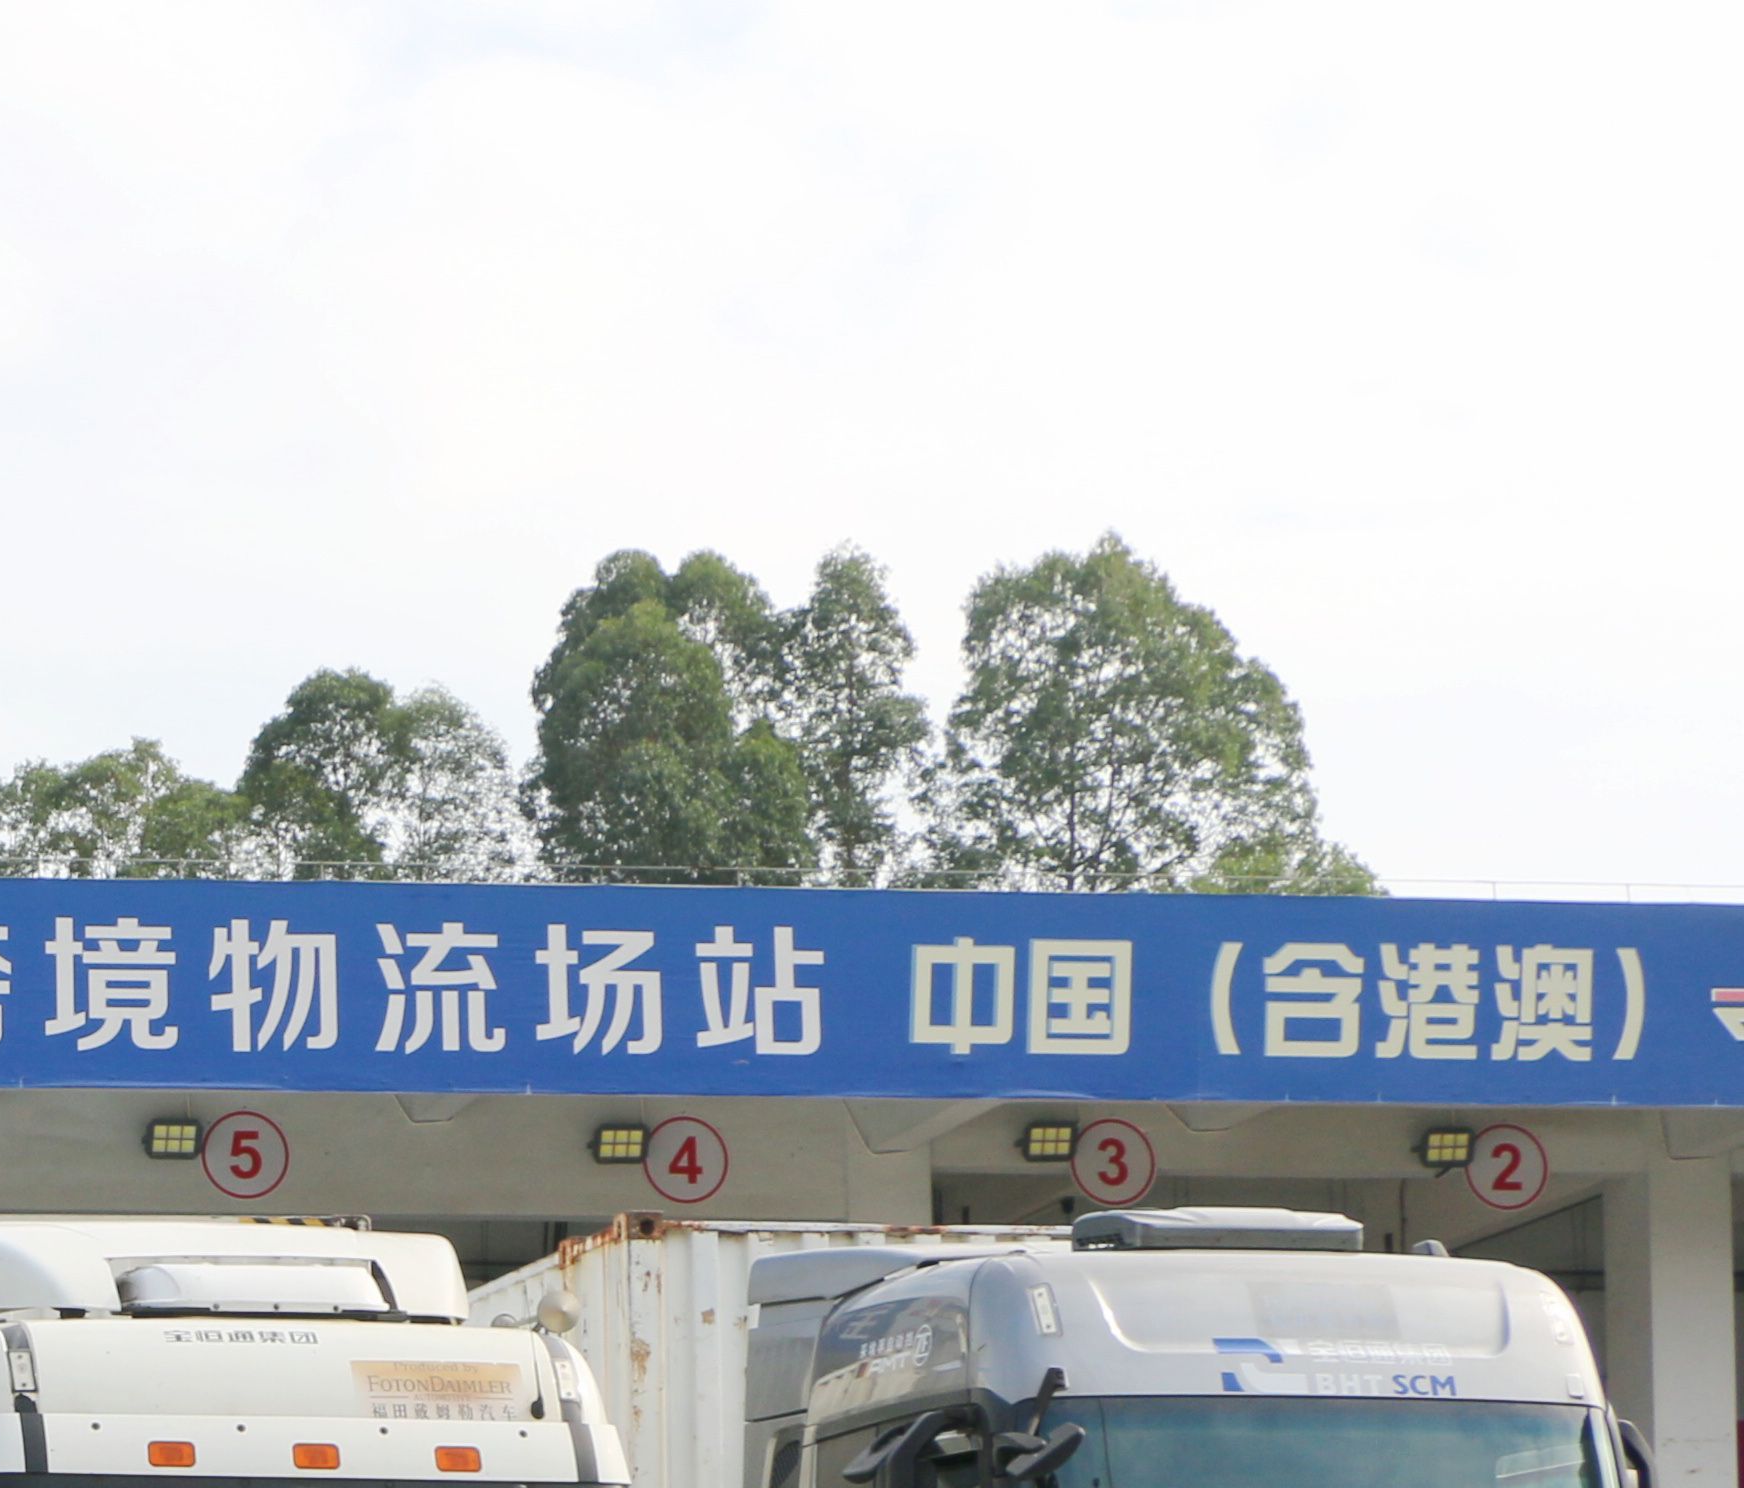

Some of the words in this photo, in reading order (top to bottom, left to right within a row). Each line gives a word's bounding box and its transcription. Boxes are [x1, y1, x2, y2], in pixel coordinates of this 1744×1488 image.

[229, 1130, 262, 1180] 5
[668, 1136, 703, 1185] 4
[1097, 1138, 1129, 1188] 3
[1492, 1143, 1524, 1192] 2
[164, 1330, 319, 1345] 宝恒通集团
[1315, 1374, 1383, 1396] BHT
[1392, 1375, 1457, 1397] SCM
